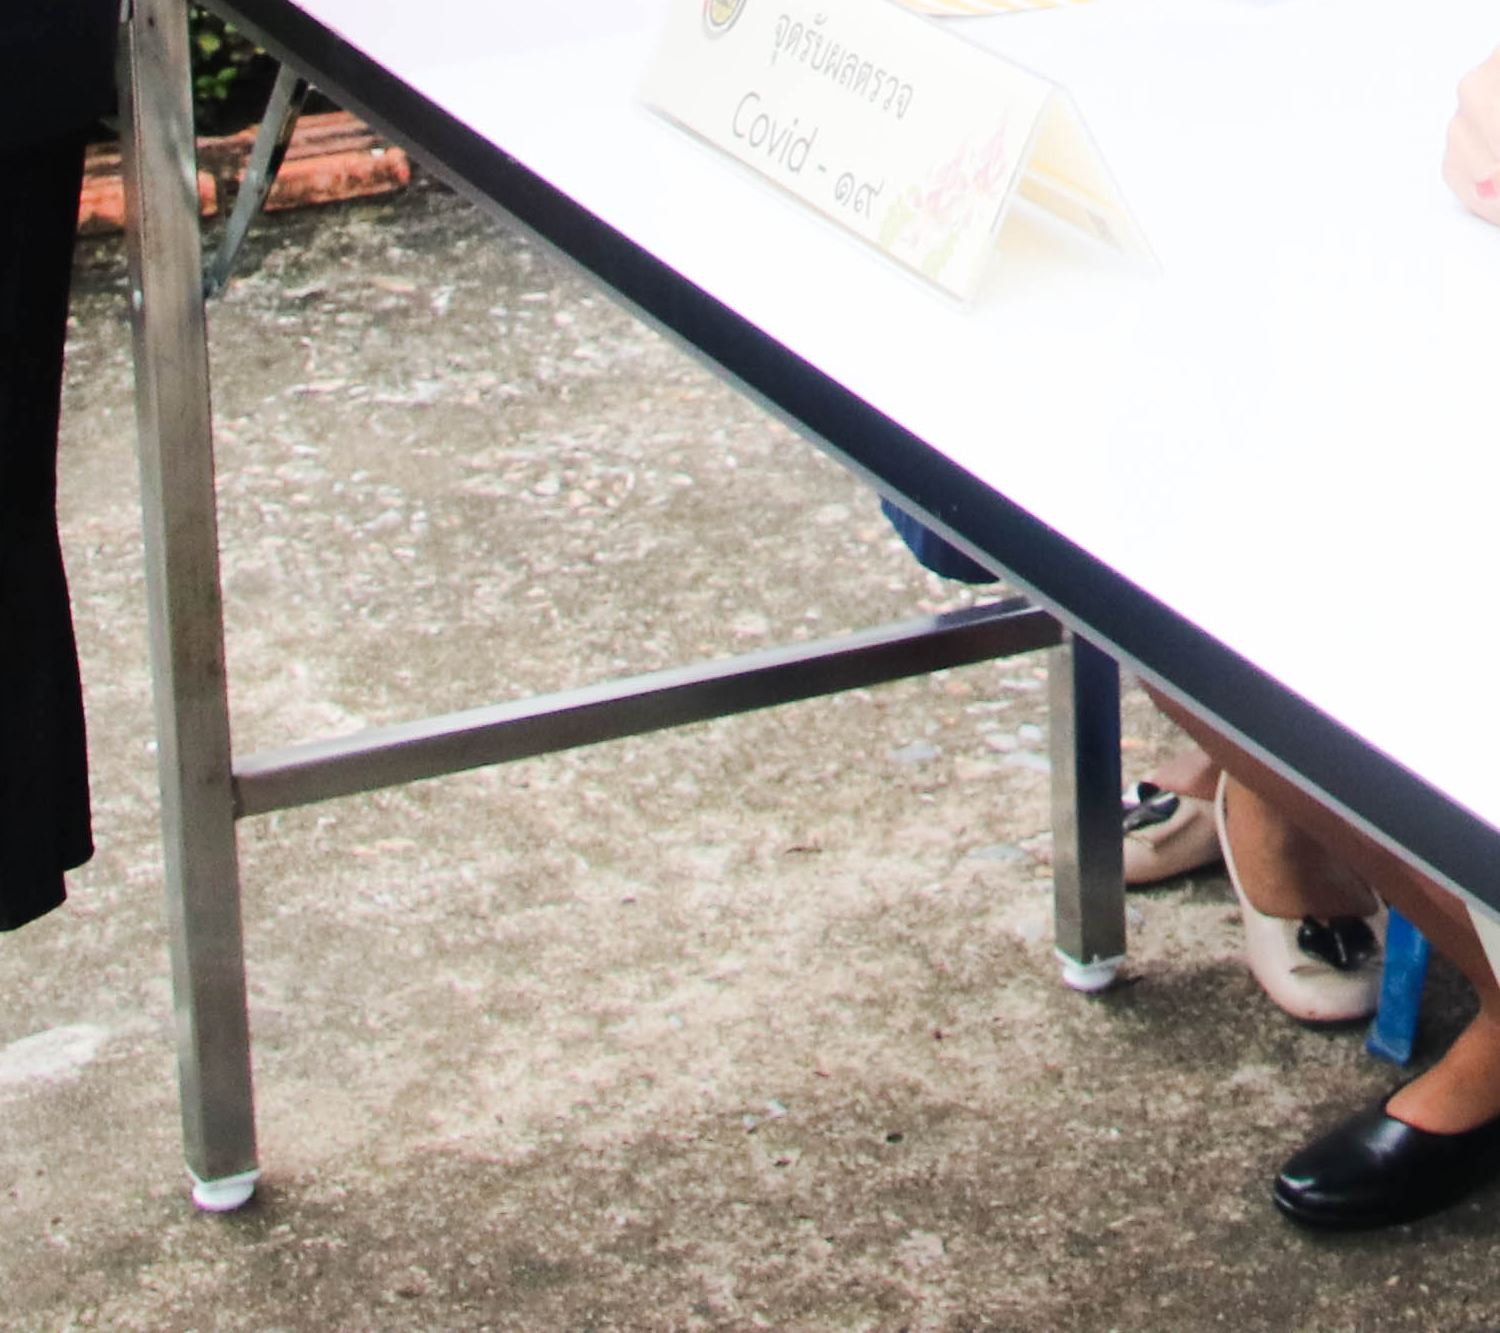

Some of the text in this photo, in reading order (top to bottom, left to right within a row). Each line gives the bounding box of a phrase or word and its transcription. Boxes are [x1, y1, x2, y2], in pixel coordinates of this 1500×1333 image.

[769, 11, 915, 121] จุดรับผลตรวจ
[731, 90, 819, 174] Covid
